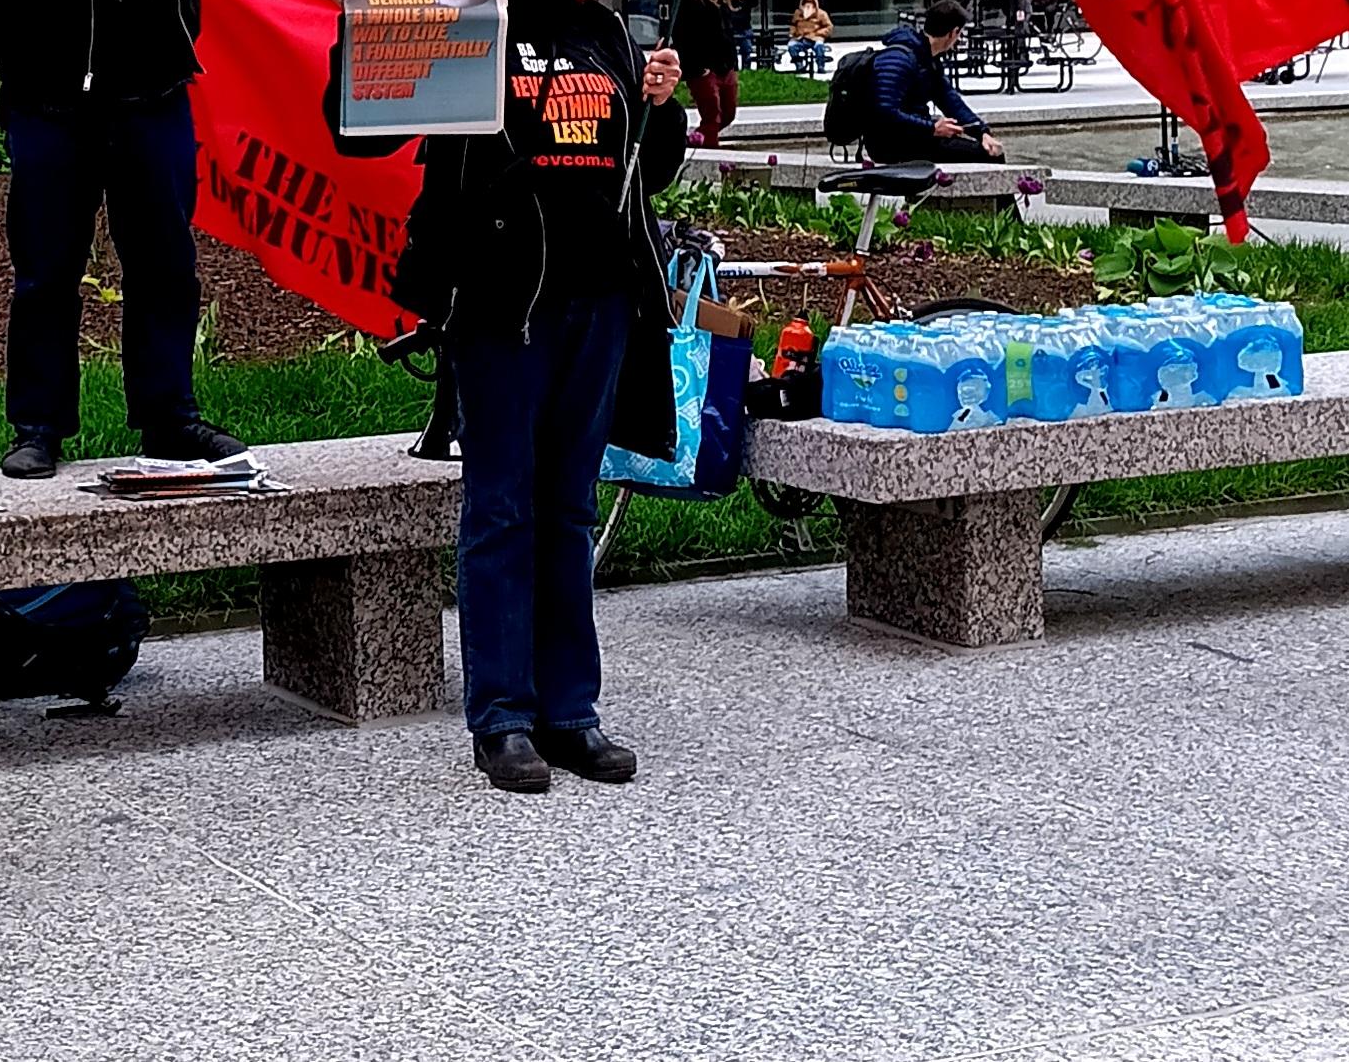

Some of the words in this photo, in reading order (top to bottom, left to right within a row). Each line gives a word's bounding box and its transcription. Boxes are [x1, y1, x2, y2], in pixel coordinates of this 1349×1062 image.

[353, 9, 364, 25] A
[367, 8, 422, 26] WHOLE
[424, 7, 461, 23] NEW
[352, 26, 389, 43] WAY
[392, 26, 411, 42] TO
[353, 44, 364, 62] A
[365, 41, 493, 61] FUNDAMENTALLY
[516, 43, 536, 57] BA
[353, 61, 433, 81] DIFFERENT
[352, 82, 416, 100] SYSTEM
[512, 72, 615, 98] EVLUTION
[532, 94, 612, 122] OTHING
[551, 120, 599, 144] LESS!
[236, 131, 337, 223] THE
